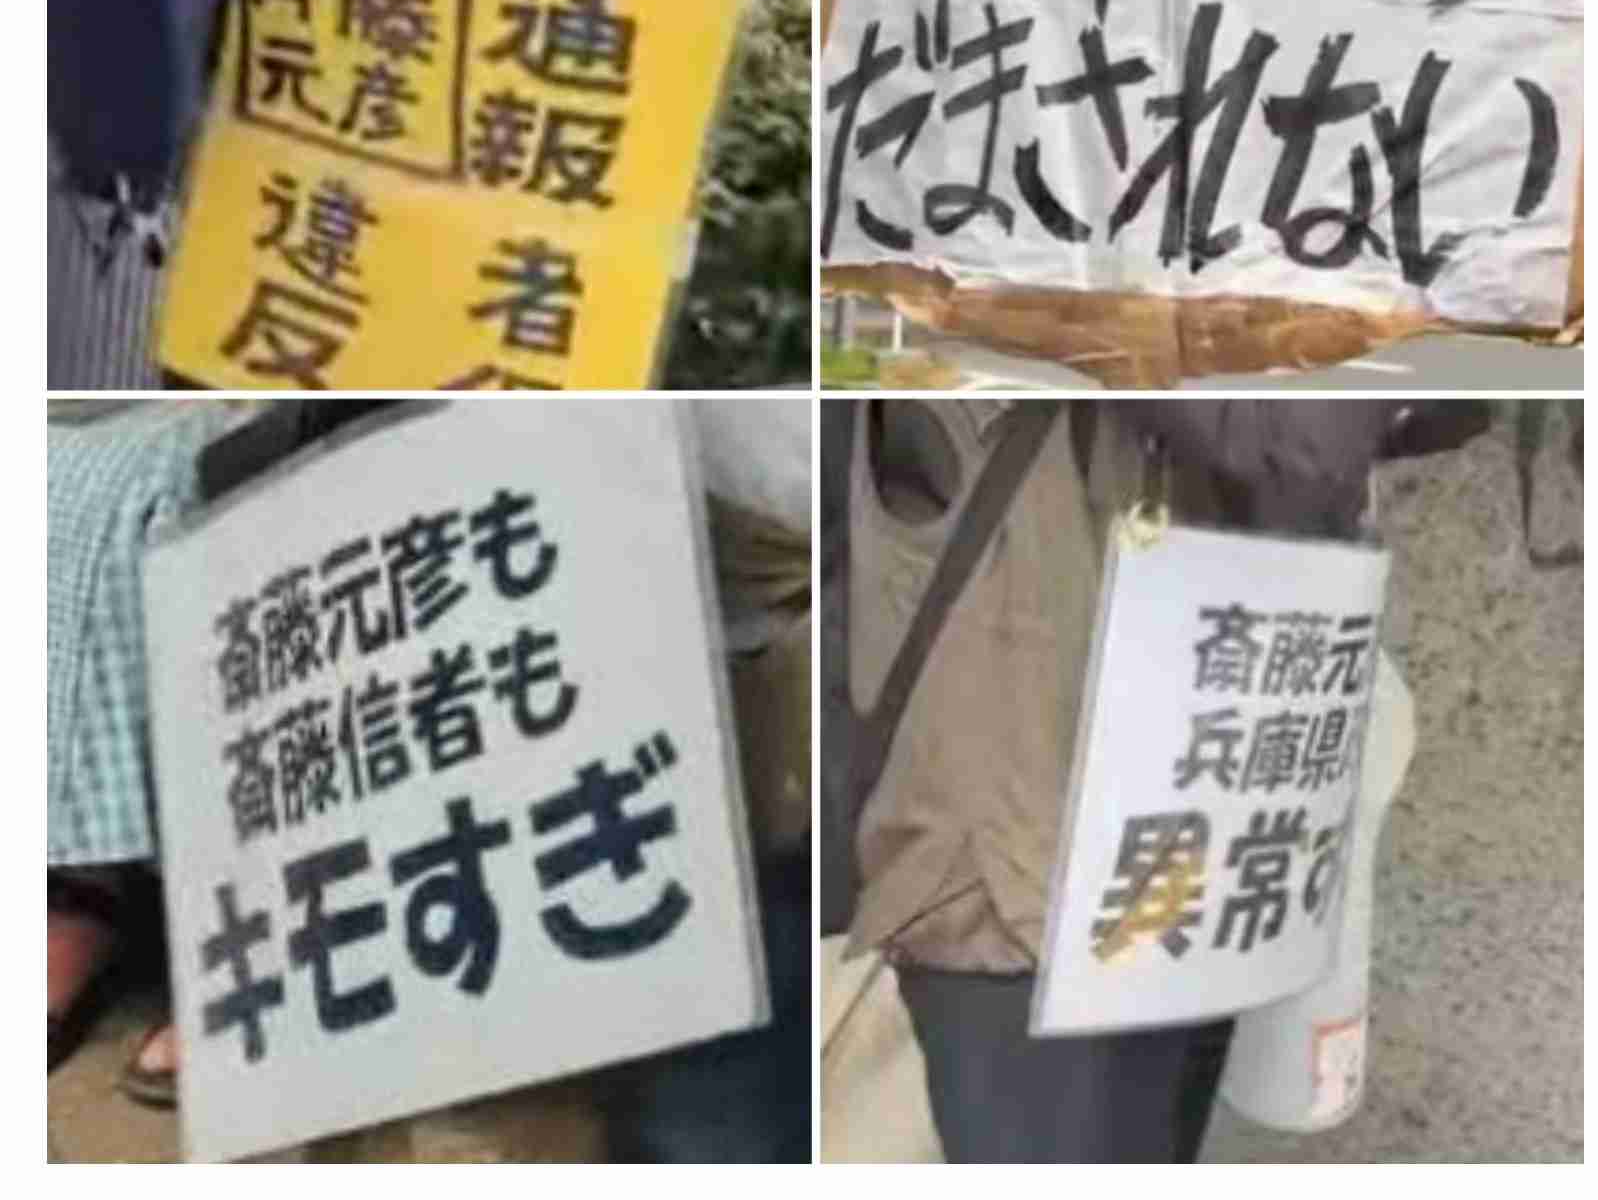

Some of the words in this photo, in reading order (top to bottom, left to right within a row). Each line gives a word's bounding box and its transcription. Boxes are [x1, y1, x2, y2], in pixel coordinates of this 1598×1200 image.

[219, 170, 380, 389] 違反
[214, 487, 558, 712] 斎藤元彦も
[222, 626, 580, 846] 斎藤信者も
[1172, 706, 1368, 795] 兵庫県
[201, 731, 693, 1064] キモすぎ
